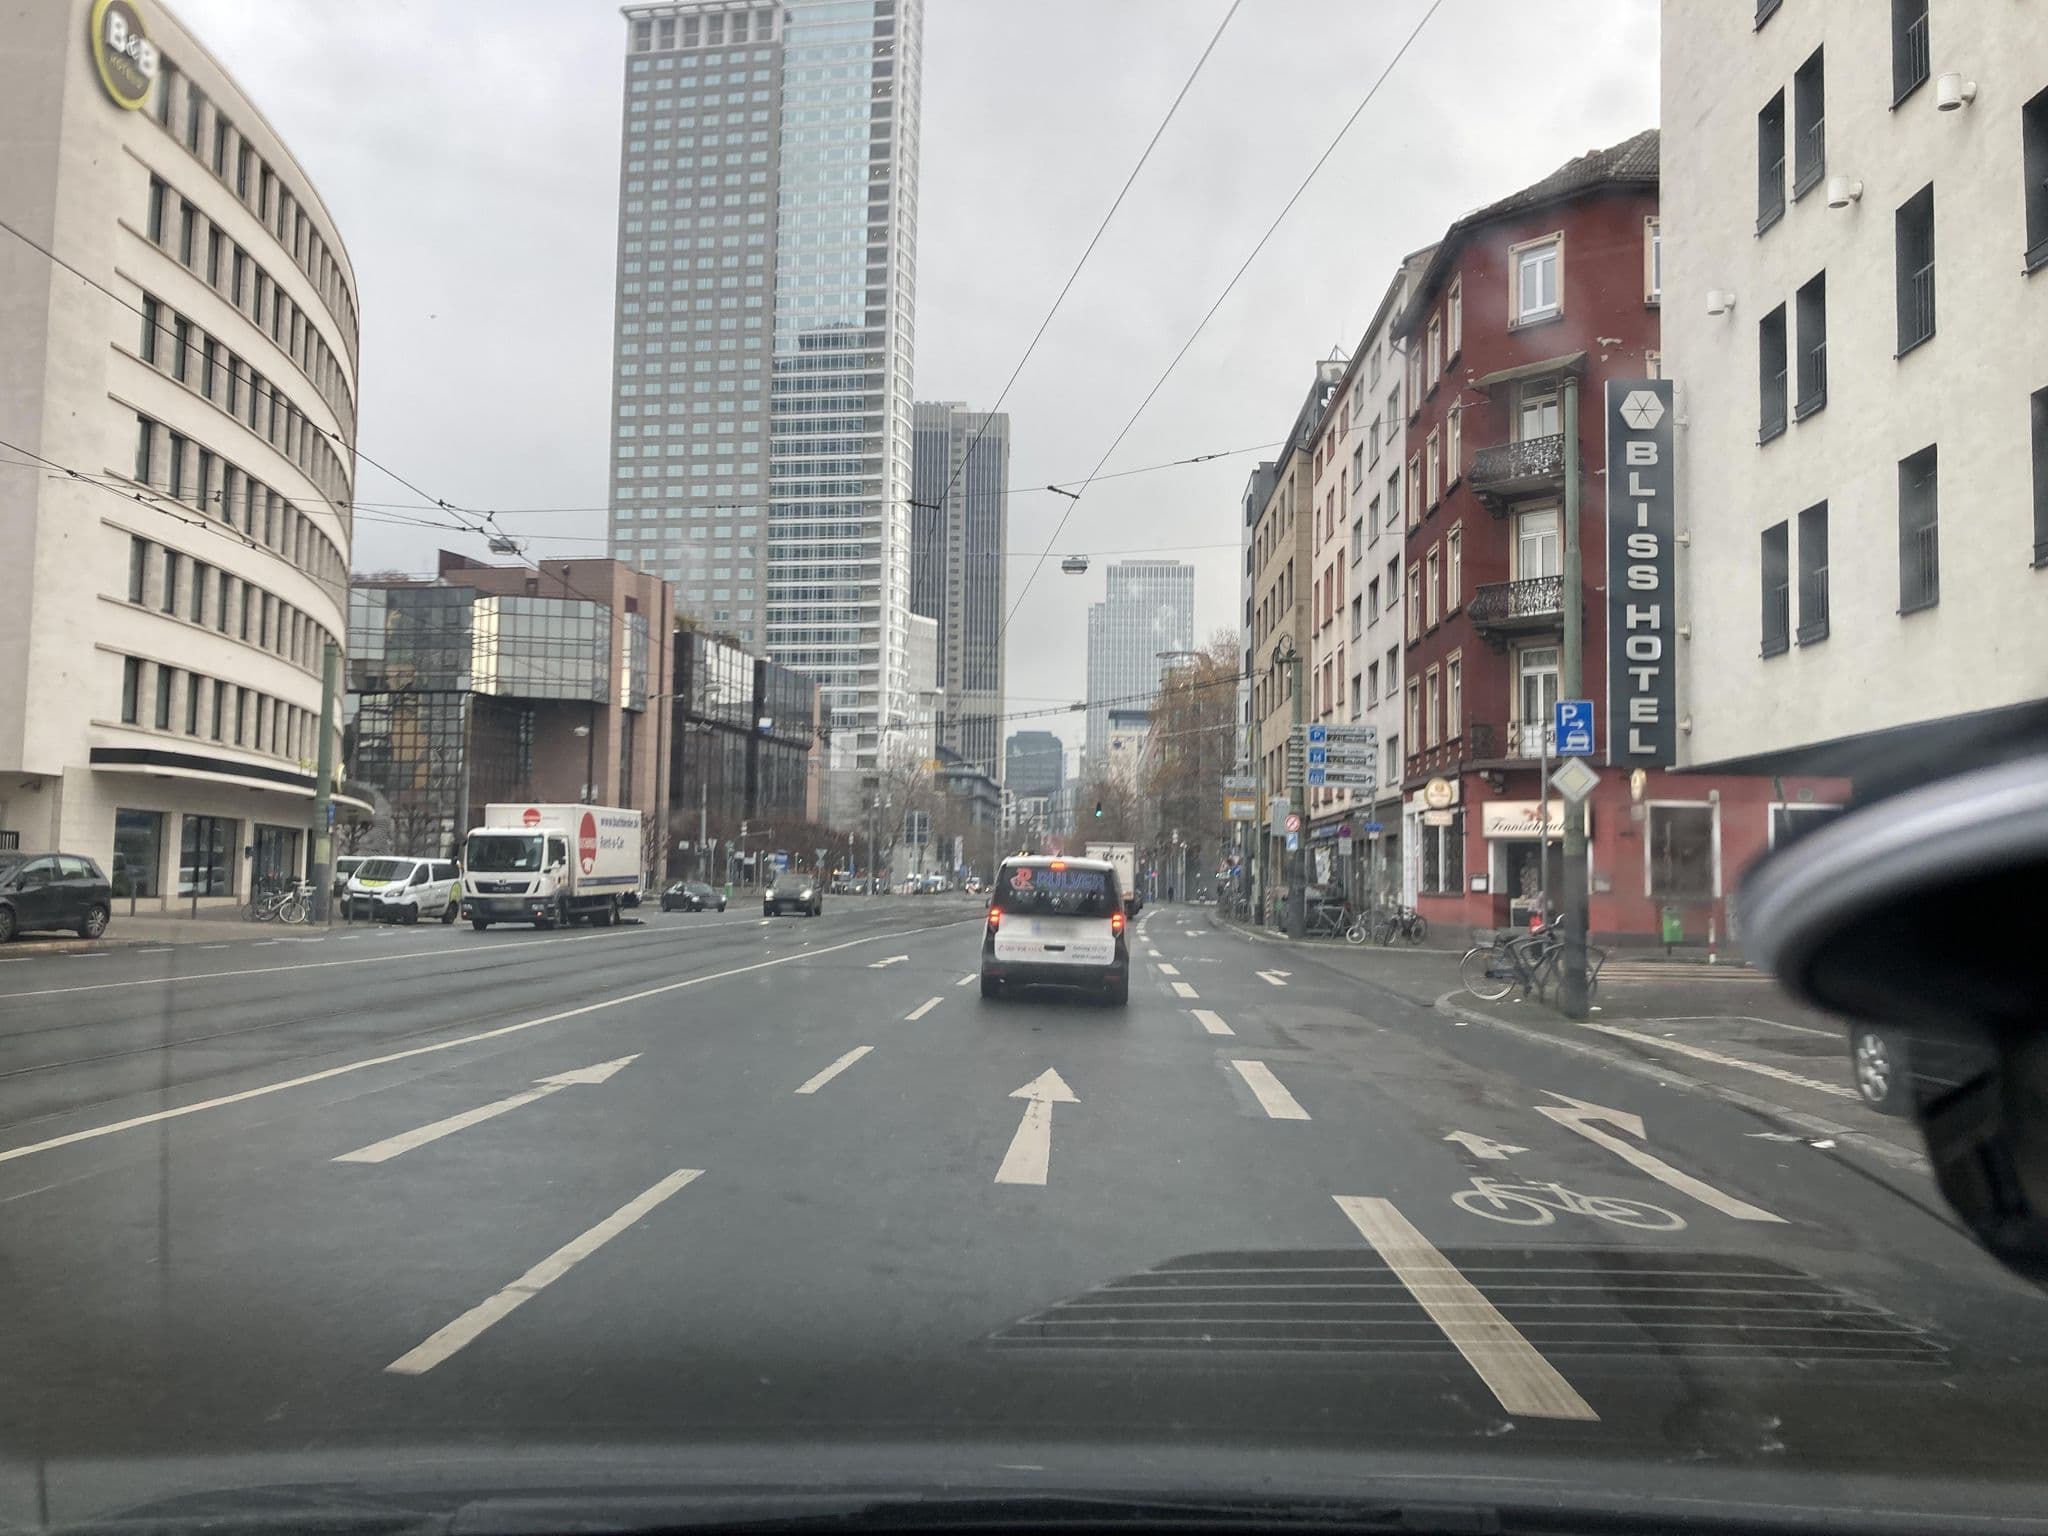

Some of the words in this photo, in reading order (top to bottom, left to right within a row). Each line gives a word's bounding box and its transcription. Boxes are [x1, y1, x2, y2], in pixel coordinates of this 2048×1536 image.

[106, 10, 158, 79] B&B
[1625, 441, 1659, 591] BLISS
[1561, 704, 1578, 727] P
[1625, 603, 1662, 755] HOTEL
